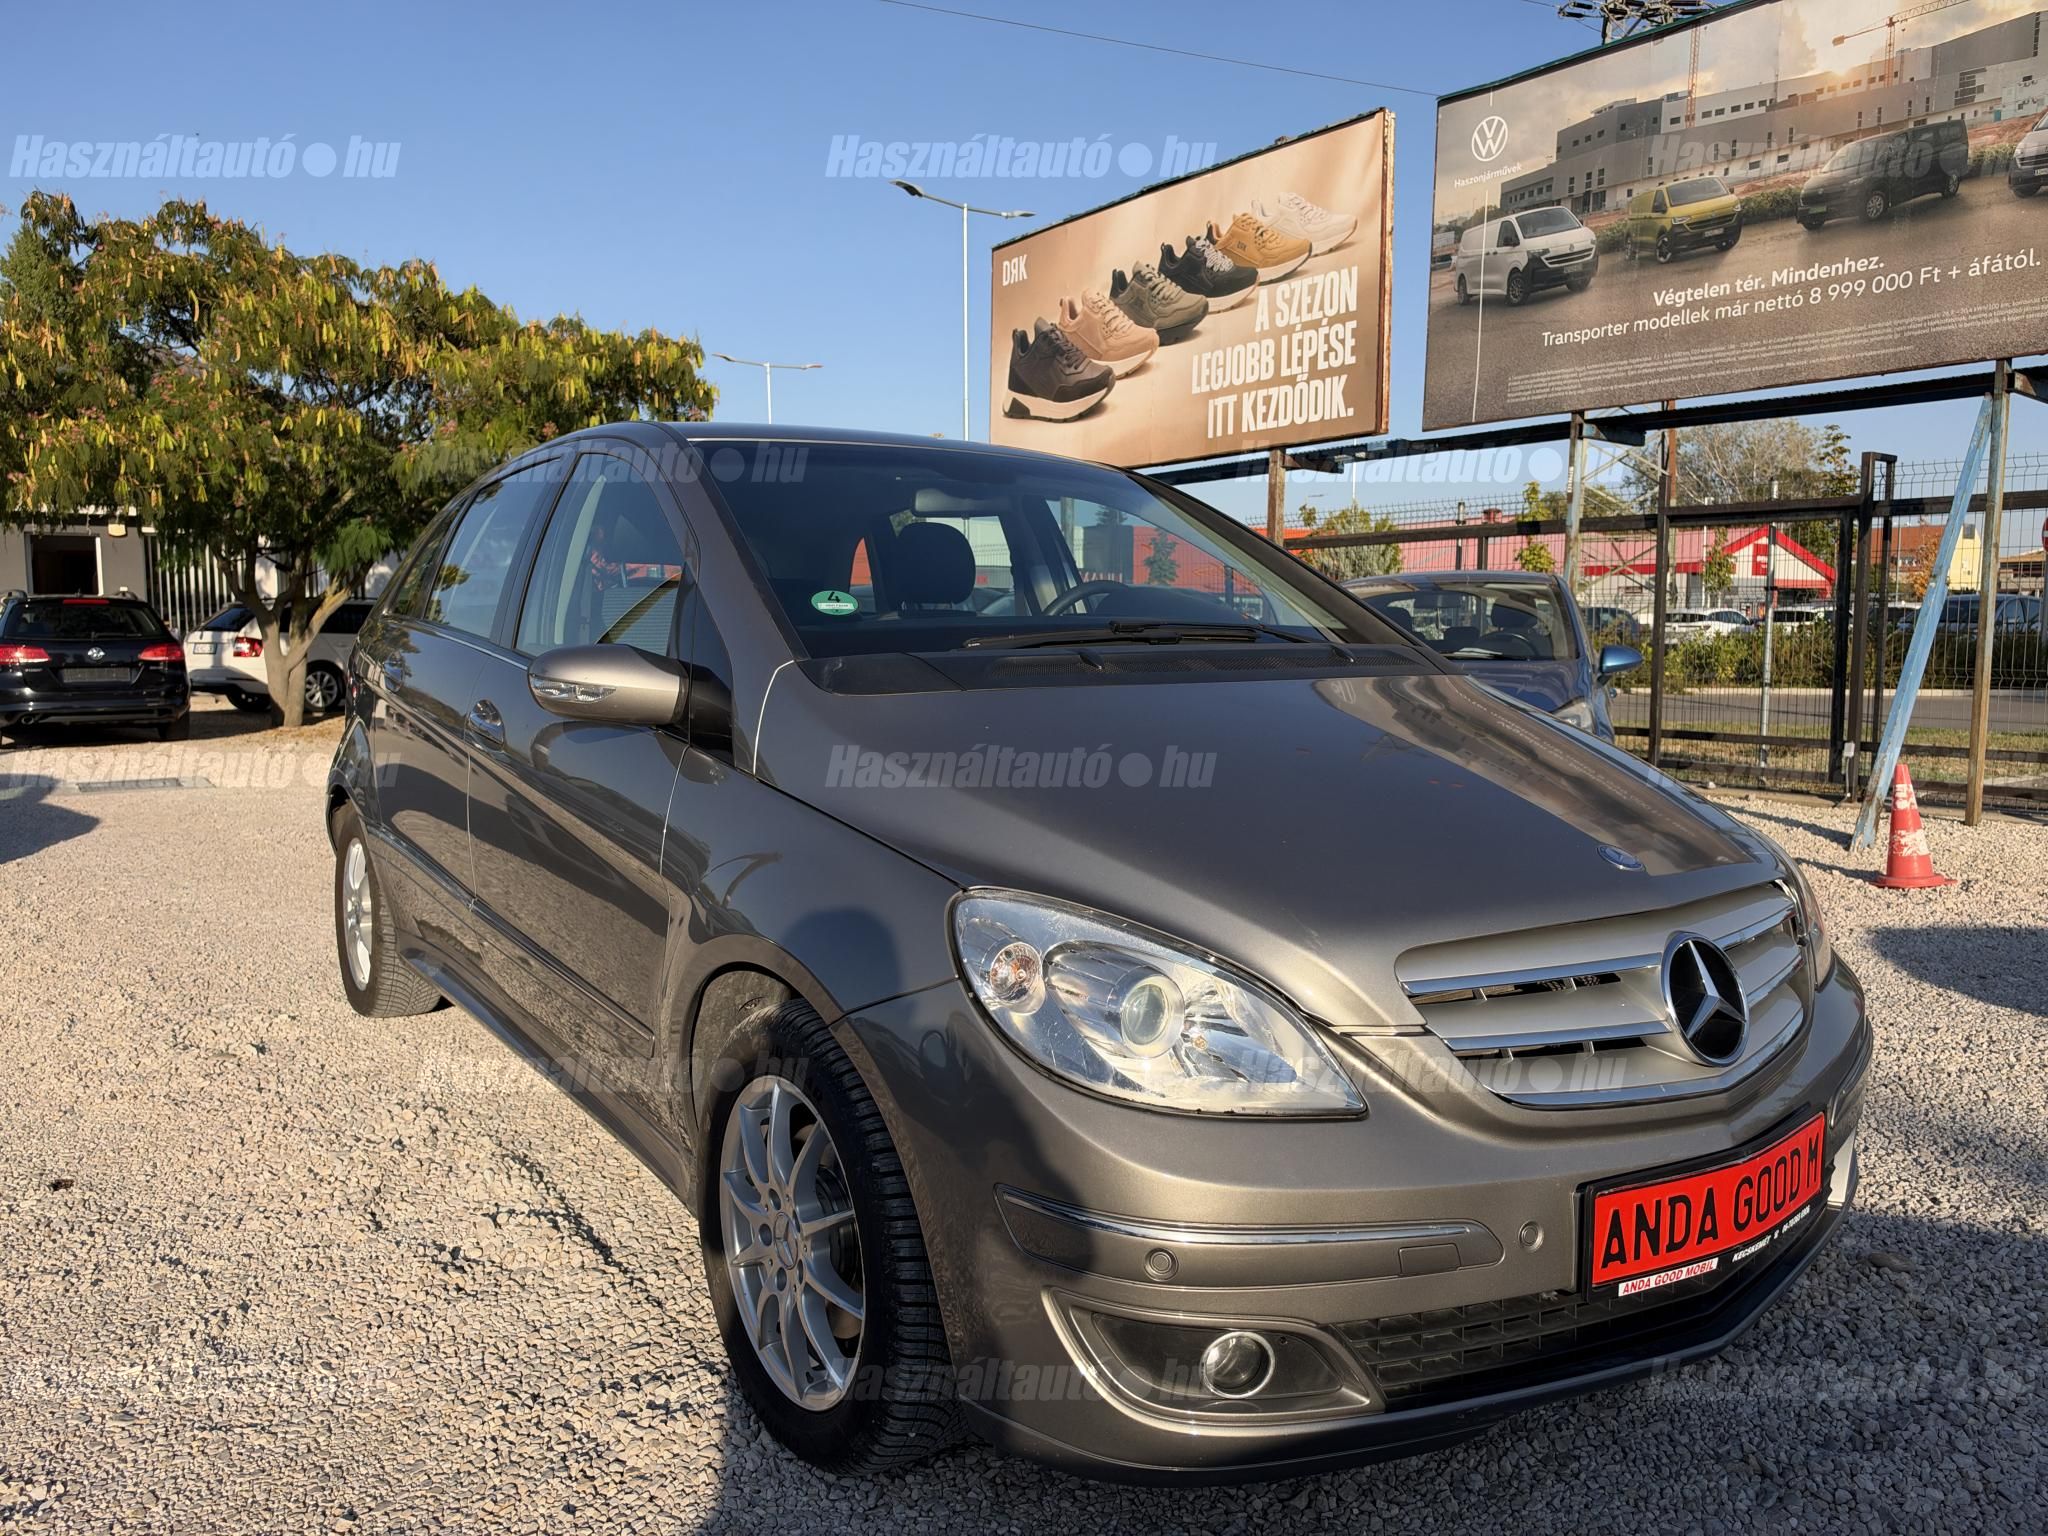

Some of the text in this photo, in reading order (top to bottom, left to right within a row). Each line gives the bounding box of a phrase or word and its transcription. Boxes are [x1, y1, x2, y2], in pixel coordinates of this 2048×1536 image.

[1454, 161, 1523, 189] Haszonjárművek
[1254, 266, 1358, 333] A SZEZON
[1542, 248, 2042, 348] Transporter modellek már nettó 8 999 000 Ft + áfától.
[1653, 252, 1885, 310] Végtelen tér. Mindenhez.
[1191, 313, 1357, 395] LEGJOBB LÉPÉSE
[1207, 373, 1355, 439] ITT KEZDŐDIK.
[828, 591, 840, 602] 4
[1601, 1132, 1820, 1268] ANDA GOOD M
[1623, 1260, 1716, 1295] ANDA GOOD MOBIL
